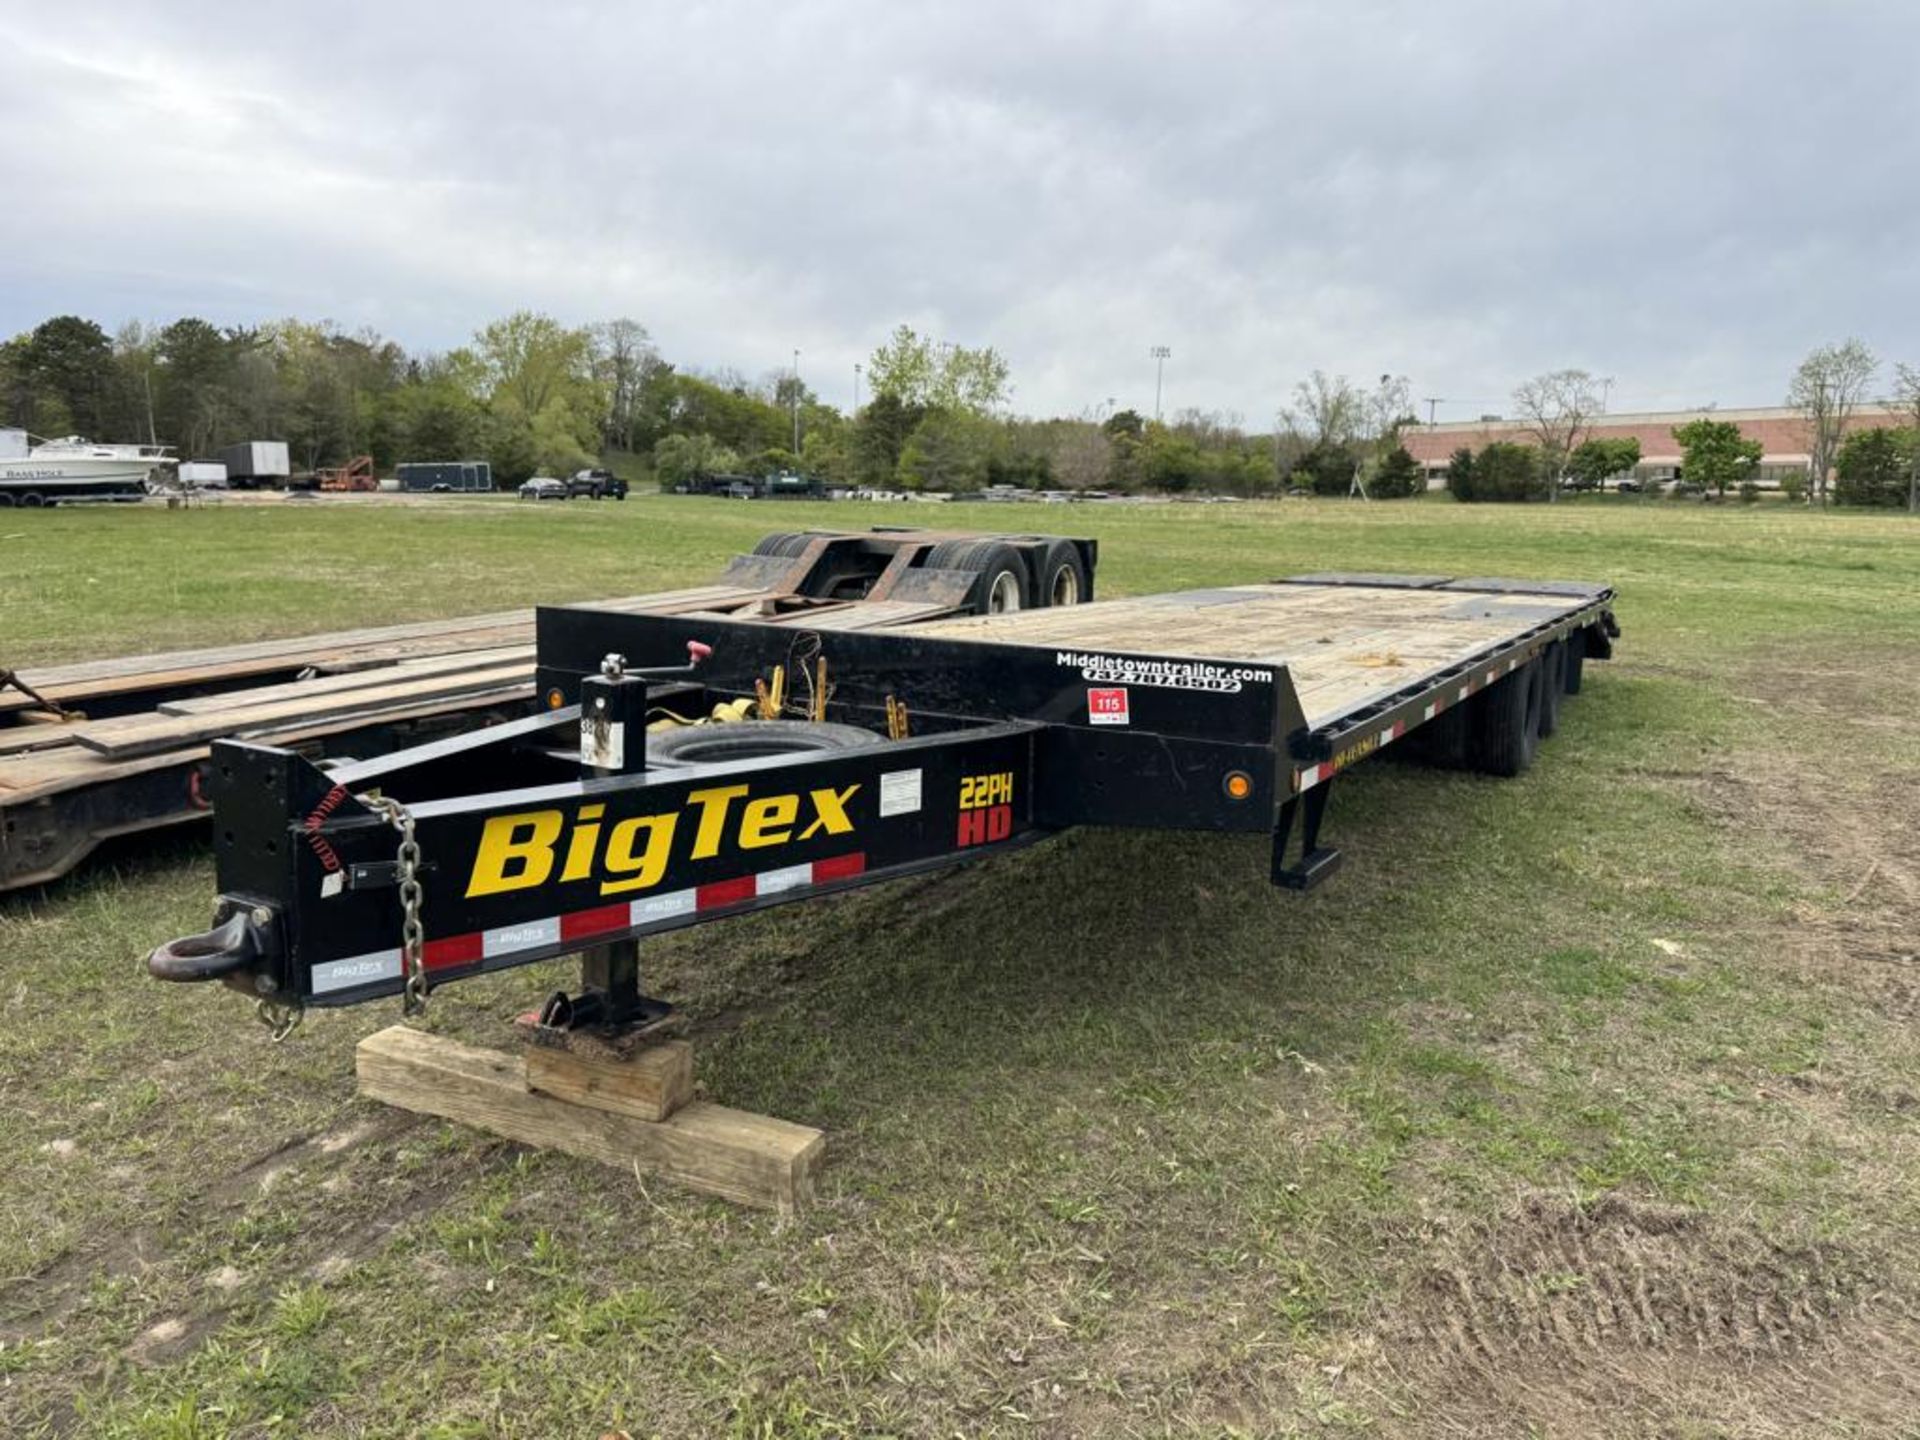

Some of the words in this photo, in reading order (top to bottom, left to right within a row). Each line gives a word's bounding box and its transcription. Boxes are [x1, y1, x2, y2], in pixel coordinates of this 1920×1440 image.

[1056, 652, 1272, 682] Middletowntrailer.com
[1097, 697, 1120, 711] 115
[959, 771, 1013, 809] 22PH
[957, 805, 1012, 846] HD
